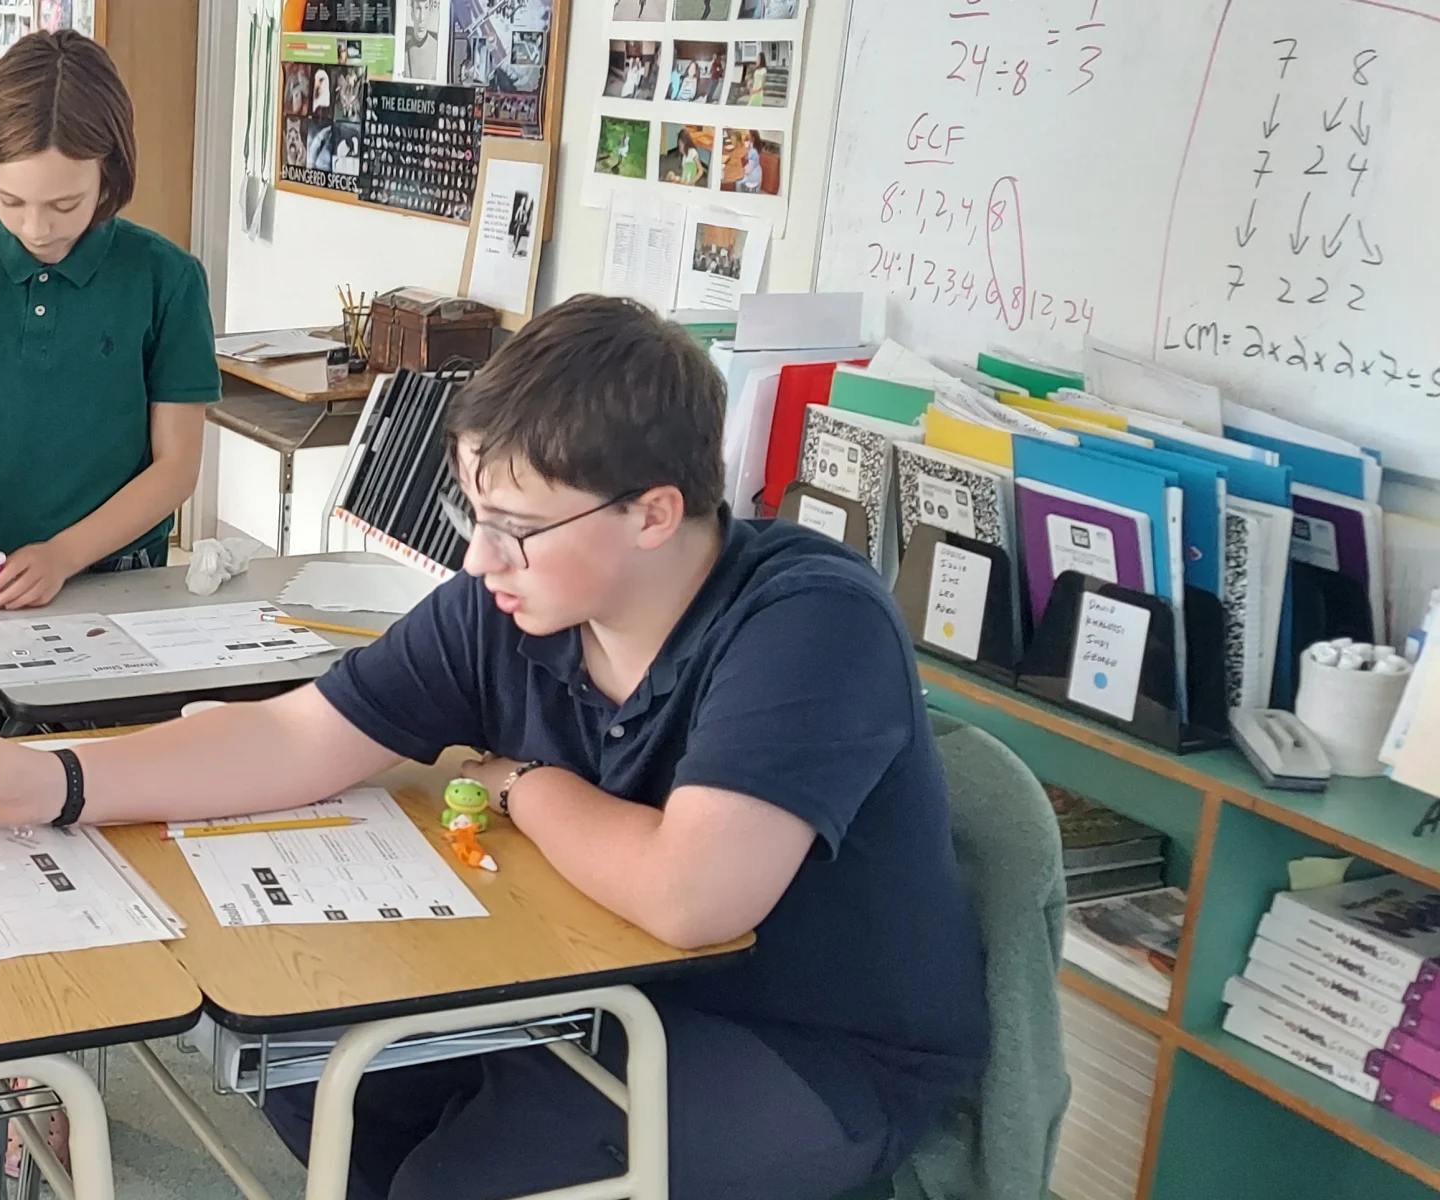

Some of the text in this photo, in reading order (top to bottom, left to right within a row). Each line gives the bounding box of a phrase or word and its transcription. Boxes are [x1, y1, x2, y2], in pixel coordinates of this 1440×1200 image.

[1067, 46, 1103, 96] 3
[1273, 38, 1378, 86] 7 8
[381, 96, 436, 116] THE ELEMENTS
[907, 112, 965, 157] GCF
[281, 165, 359, 194] ENDANGERED SPECIES
[1253, 144, 1369, 198] 7 2 4
[1227, 264, 1367, 312] 7 2 2 2
[92, 664, 123, 673] Sheet
